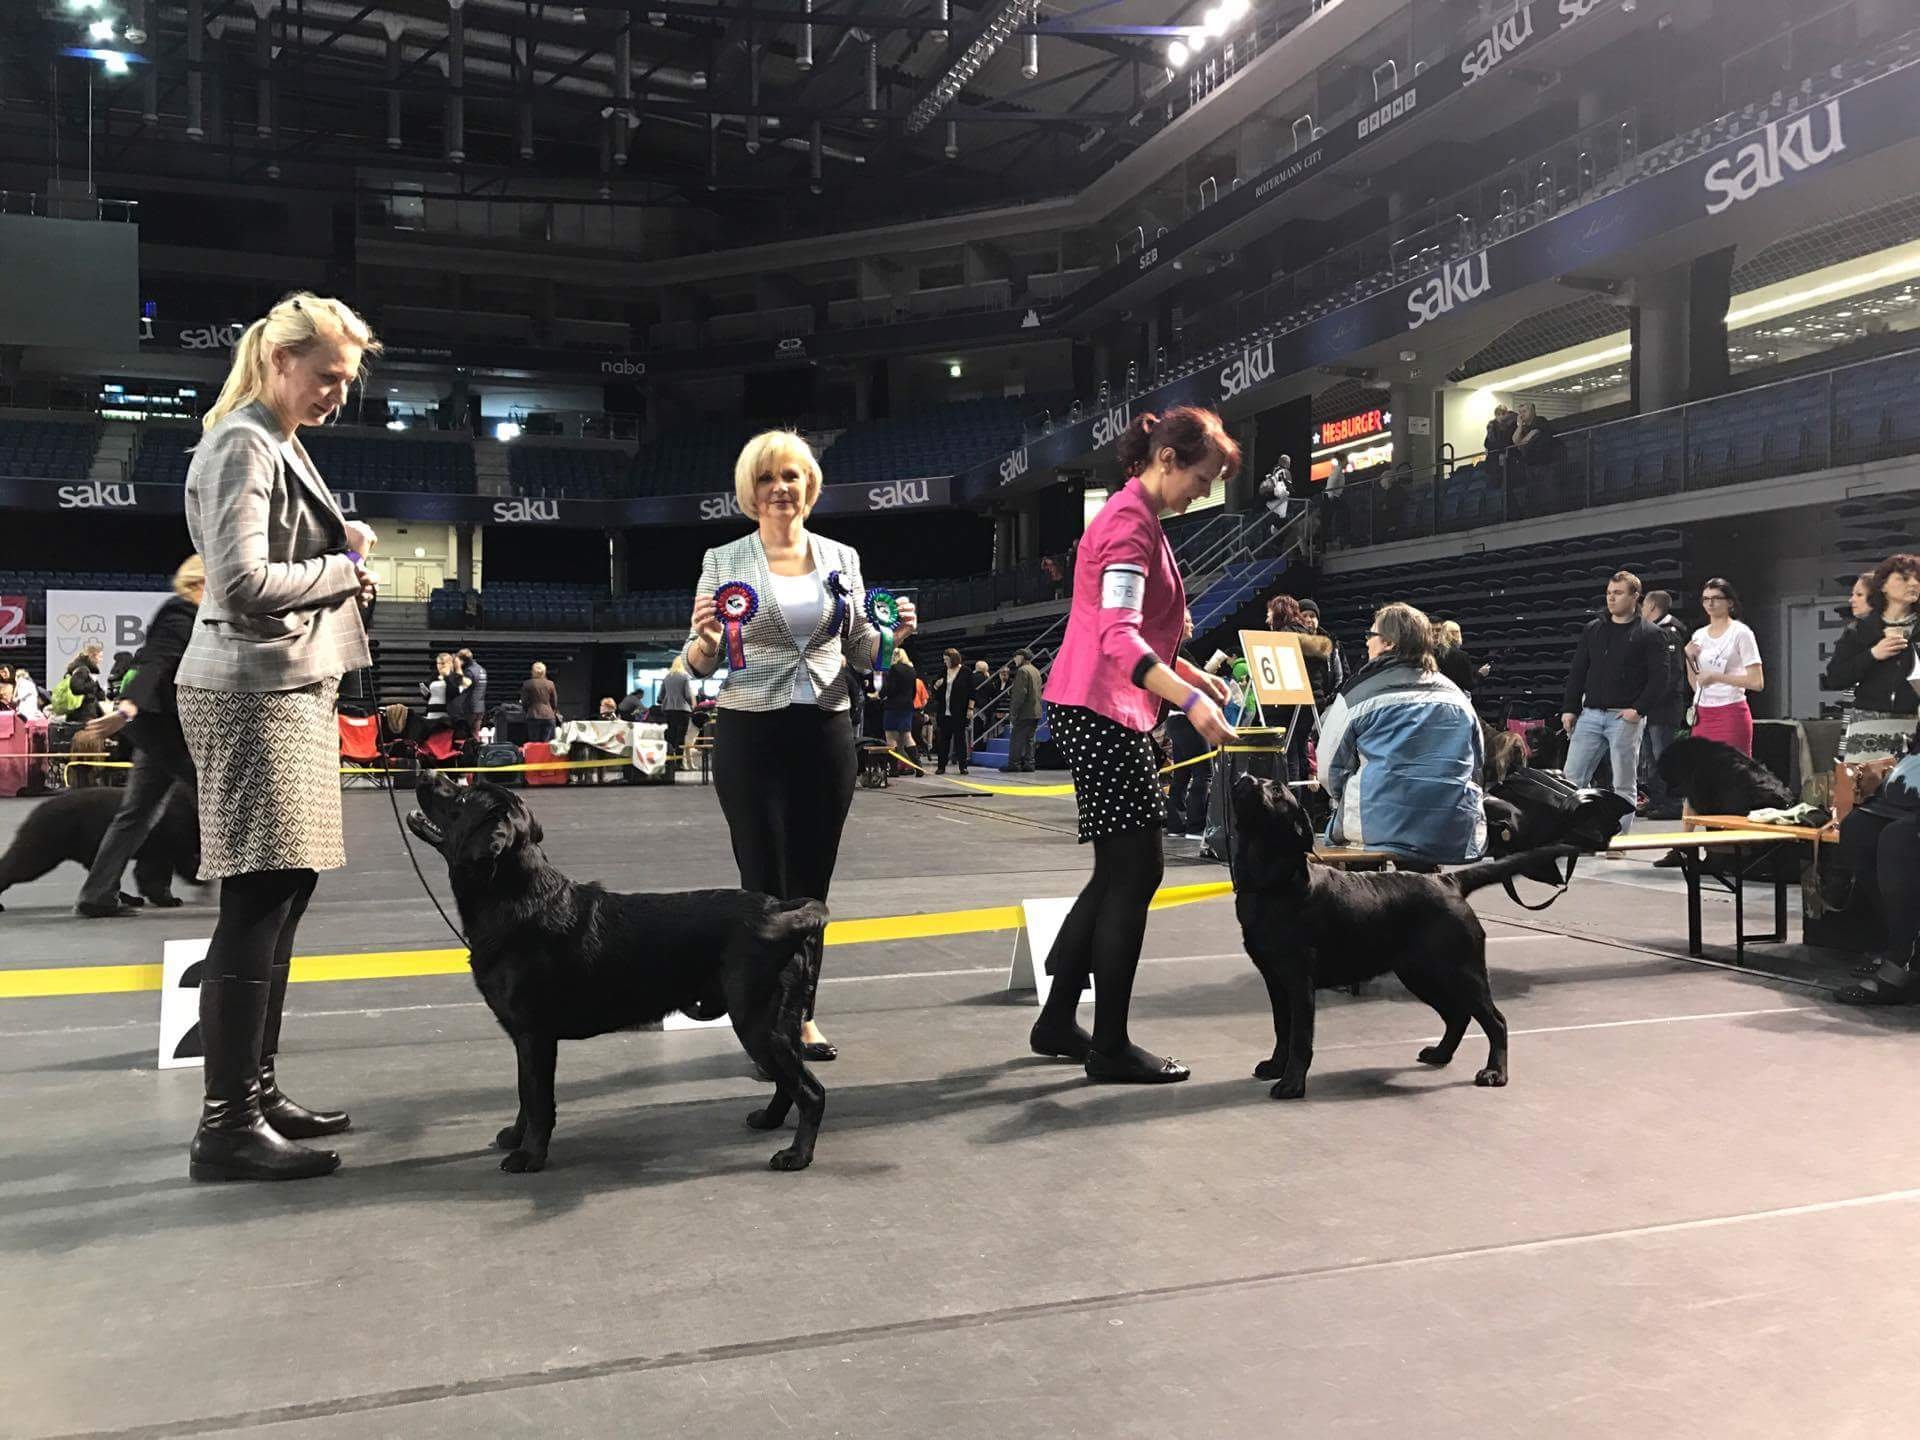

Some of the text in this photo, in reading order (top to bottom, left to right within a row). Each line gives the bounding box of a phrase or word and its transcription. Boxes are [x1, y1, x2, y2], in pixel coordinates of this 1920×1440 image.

[1461, 5, 1534, 87] saku
[1255, 149, 1323, 198] ROTERMANN CITY
[1704, 99, 1846, 215] saku
[1139, 247, 1159, 270] SEB
[1407, 250, 1491, 330] saku
[601, 357, 646, 375] naba
[1220, 341, 1275, 401] saku
[1092, 402, 1131, 451] saku
[1322, 409, 1383, 445] HESBURGER
[1000, 447, 1029, 487] saku
[57, 480, 137, 509] saku
[493, 497, 560, 523] saku
[701, 492, 743, 521] sak
[868, 480, 930, 511] saku
[1260, 655, 1276, 685] 6
